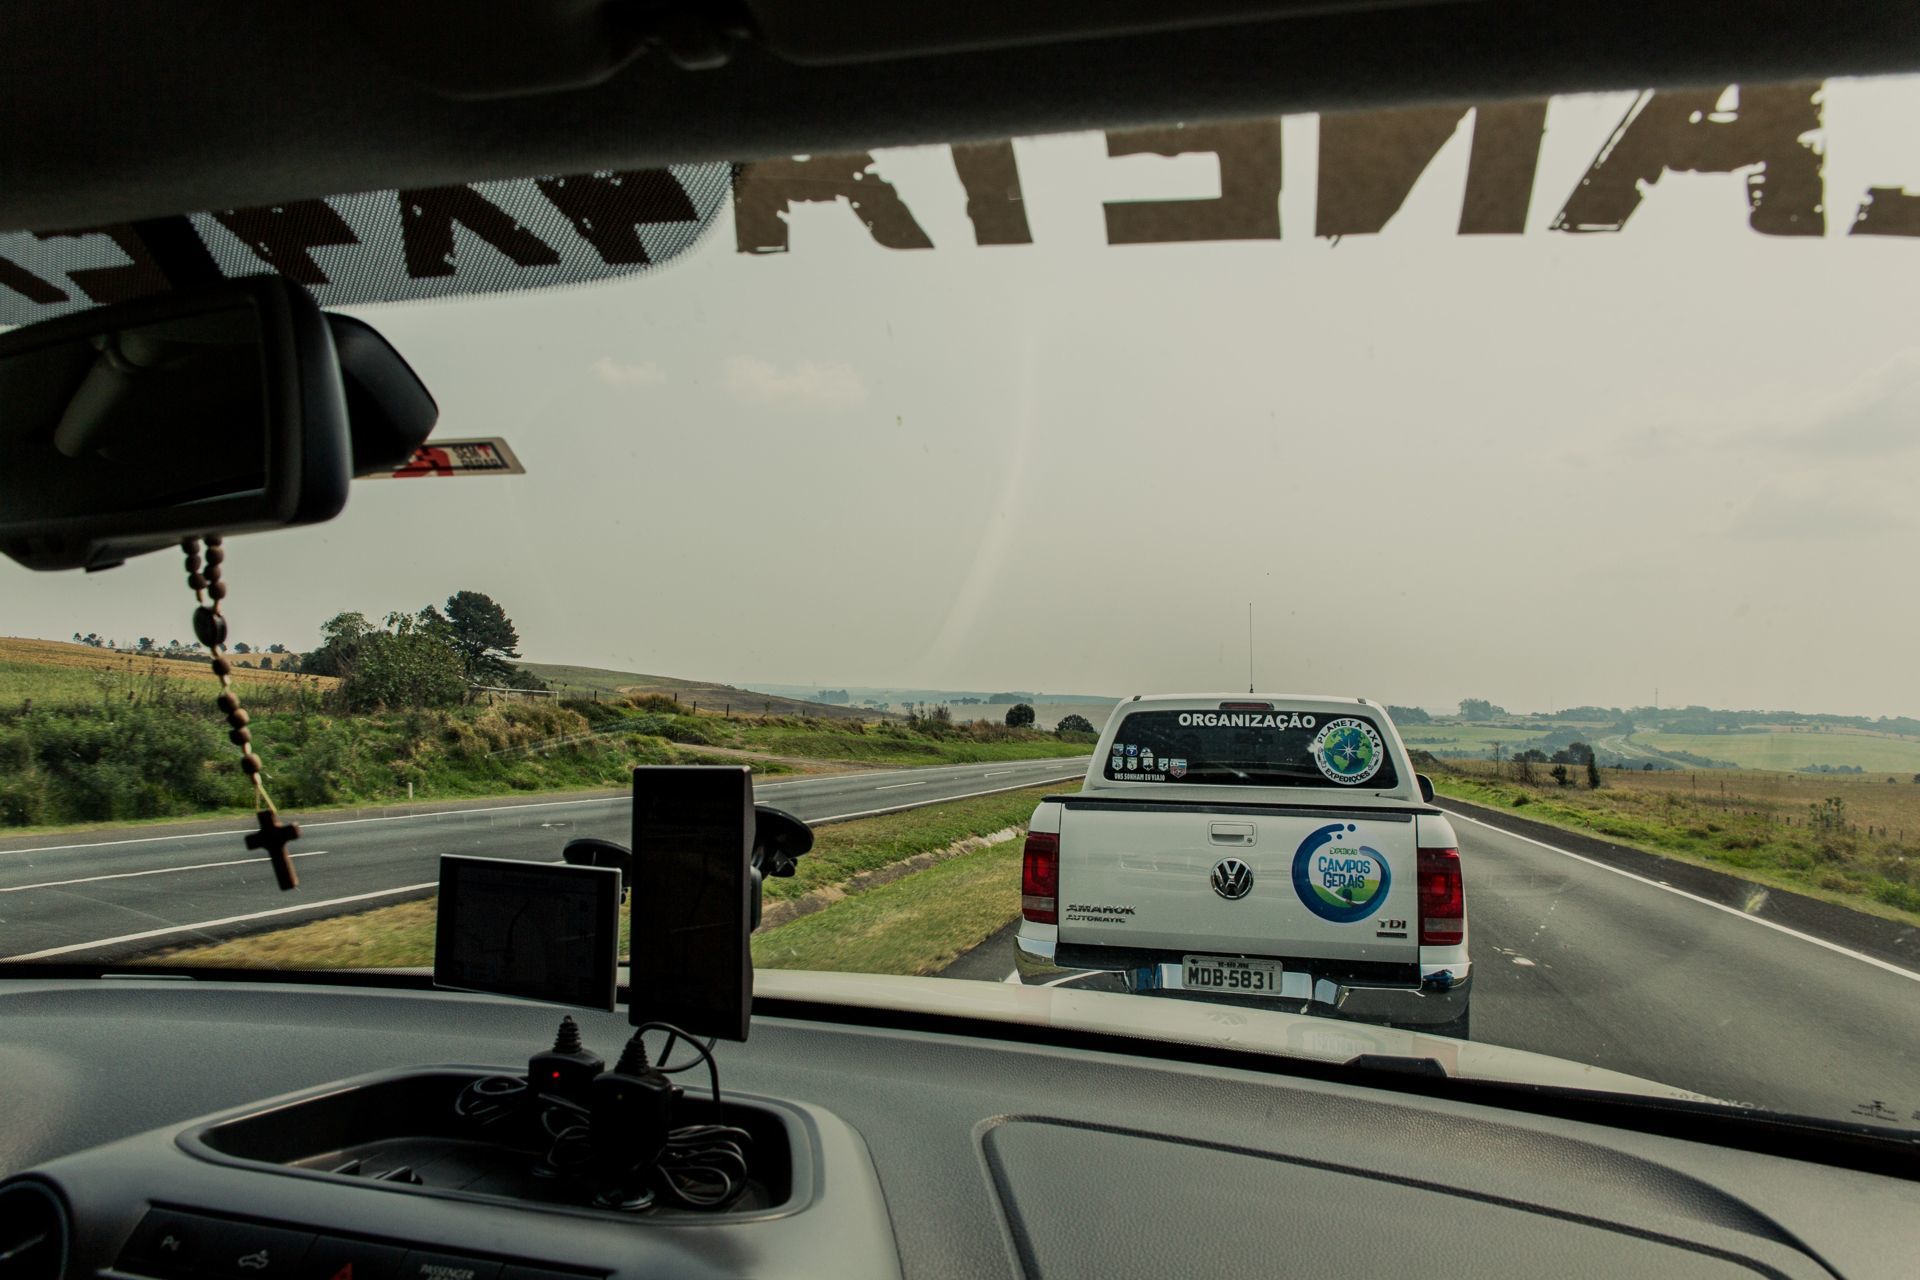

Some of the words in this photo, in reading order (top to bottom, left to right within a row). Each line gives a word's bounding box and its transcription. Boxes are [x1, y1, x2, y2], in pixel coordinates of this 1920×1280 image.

[1178, 712, 1316, 731] ORGANIZAÇÃO
[1318, 720, 1362, 744] PLANETA
[1365, 729, 1381, 749] 4X4
[1325, 768, 1371, 784] EXPEDIÇÕES
[1318, 856, 1371, 874] CAMPOS
[1066, 903, 1136, 915] AMAROK
[1066, 914, 1126, 923] AUTOMATIC
[1378, 914, 1407, 929] TDI
